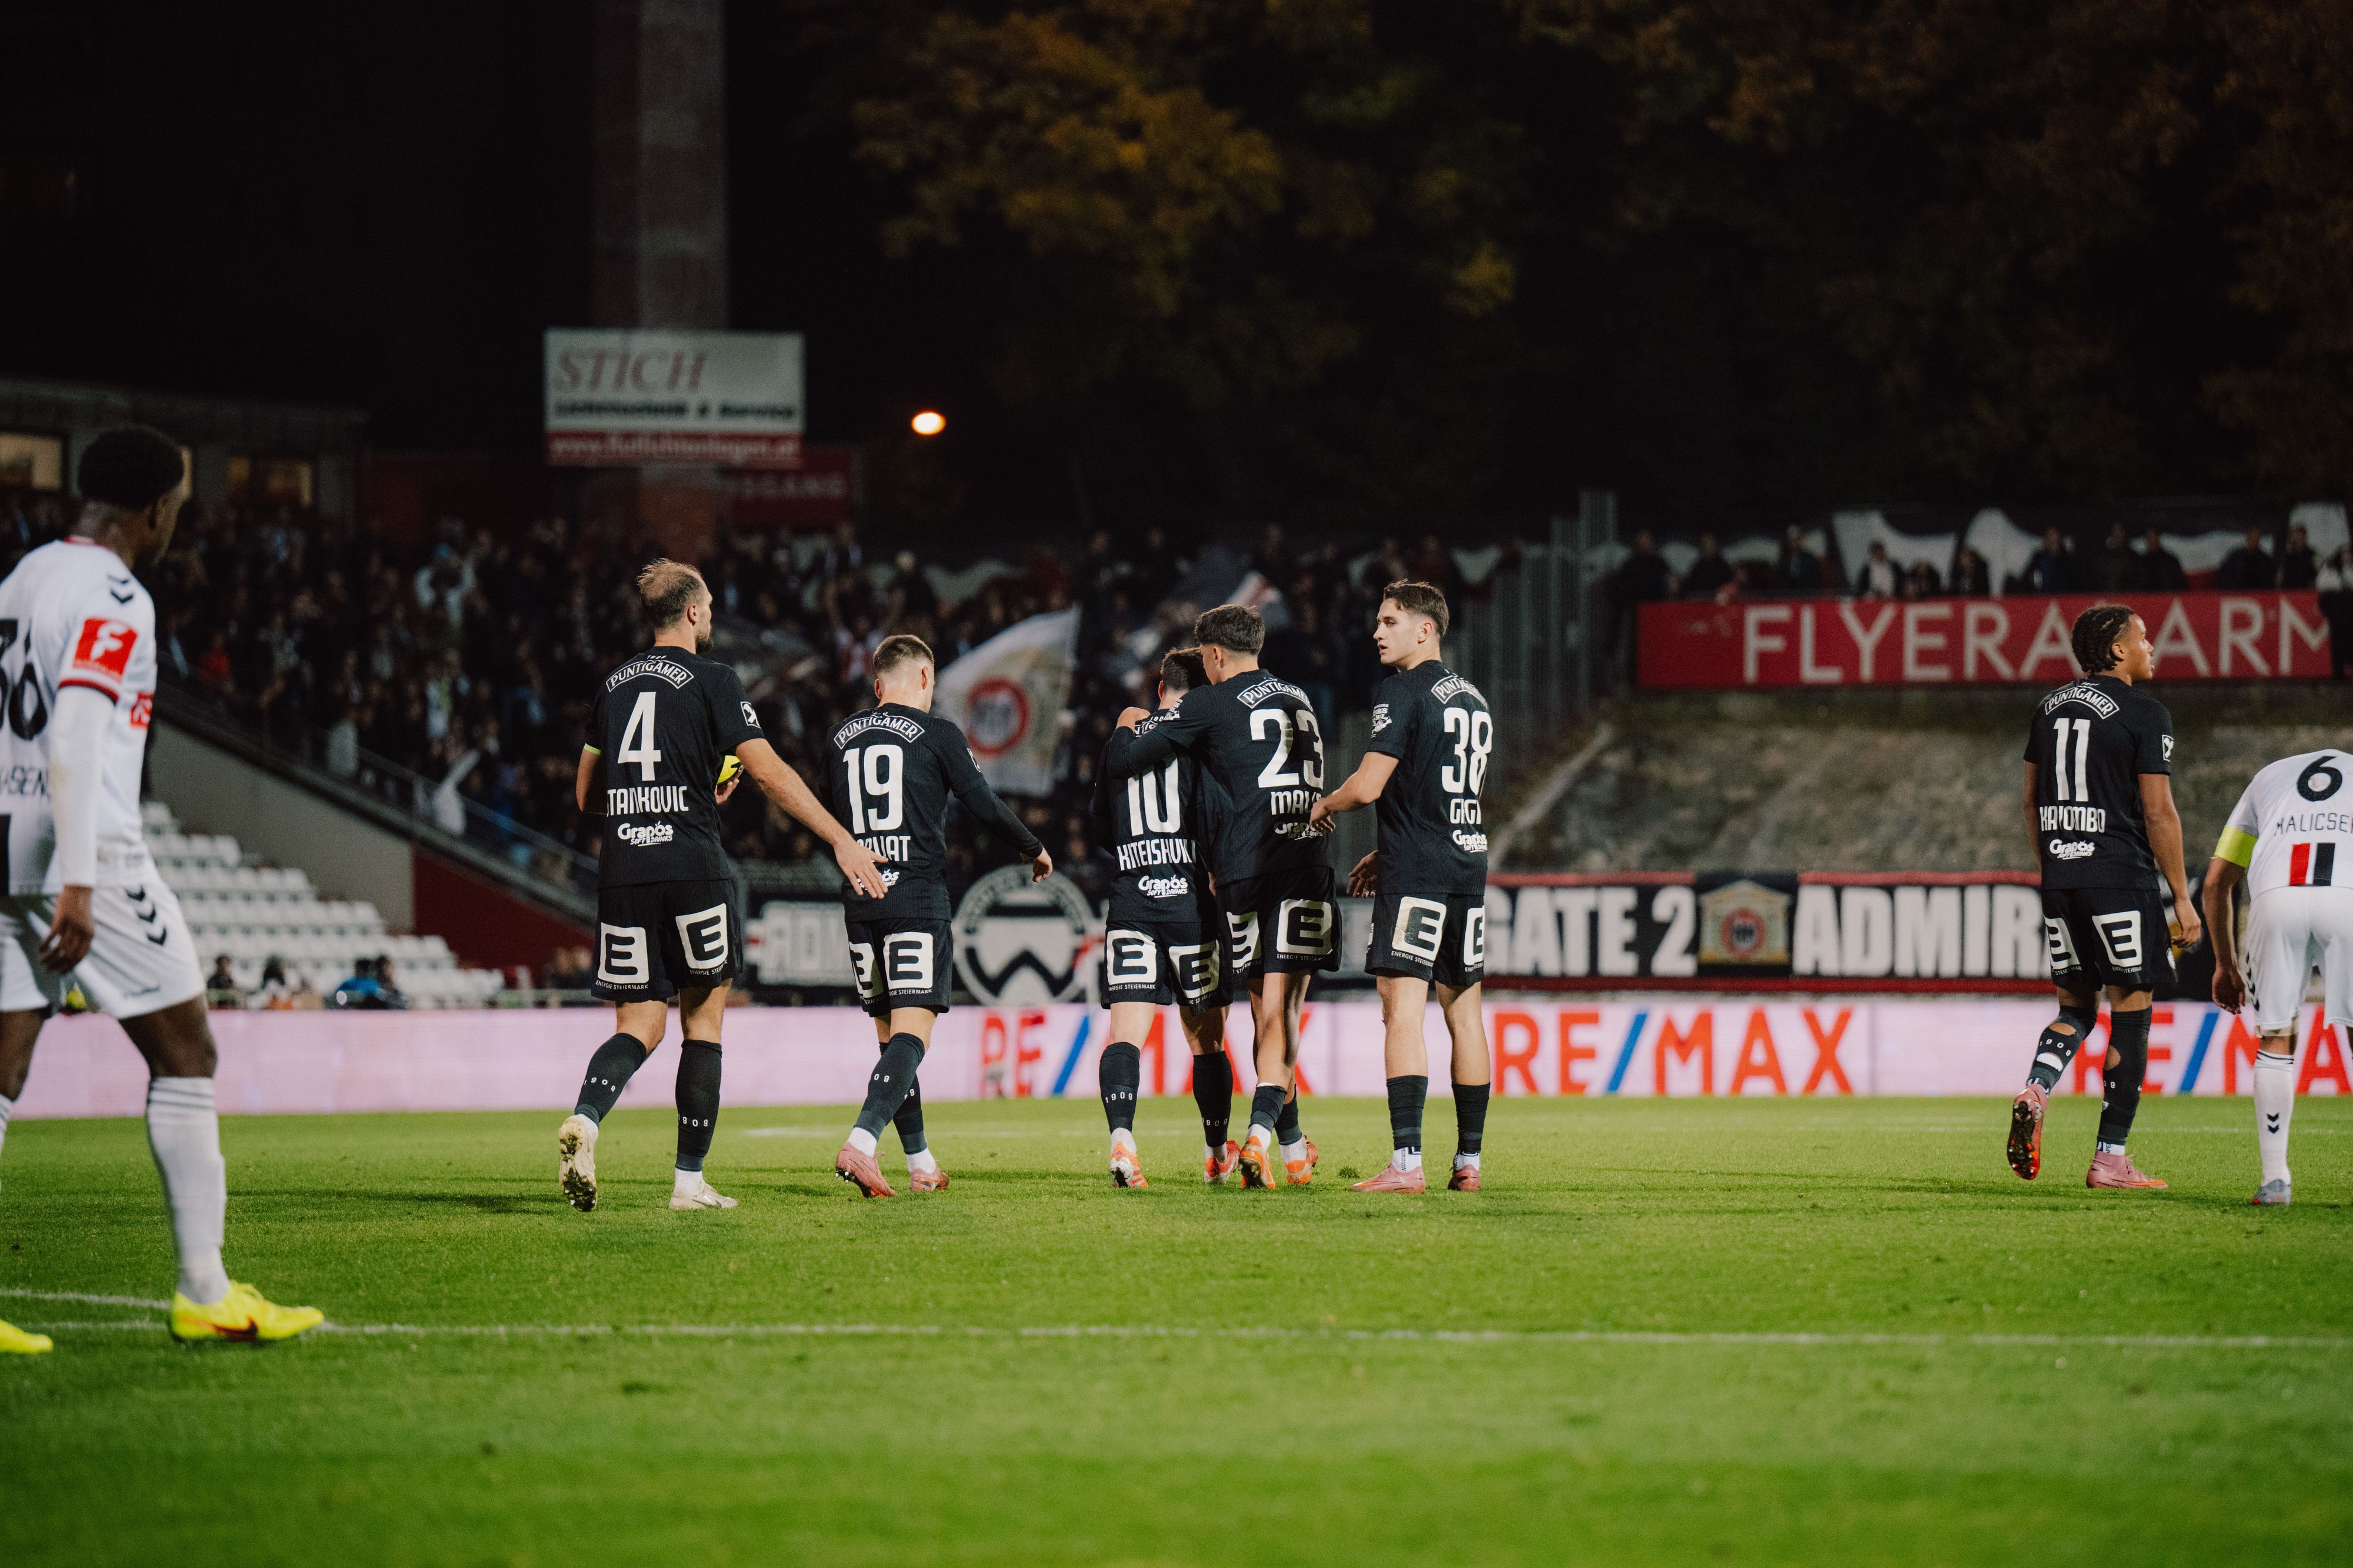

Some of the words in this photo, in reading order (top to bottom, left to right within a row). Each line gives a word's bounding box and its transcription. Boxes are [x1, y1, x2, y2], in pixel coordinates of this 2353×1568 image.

[555, 351, 706, 392] STICH
[610, 660, 688, 688] PUNTIGAMER
[1743, 596, 2331, 683] FLYERAARM
[618, 692, 661, 781] 4
[838, 715, 918, 743] PUNTIGAMER
[2048, 687, 2114, 716] PUNTIGAMER
[842, 744, 904, 835] 19
[1250, 708, 1324, 790] 23
[1442, 707, 1494, 795] 38
[2053, 718, 2091, 802] 11
[2296, 755, 2343, 802] 6
[606, 785, 689, 817] TANKOVIC
[1128, 755, 1181, 836] 10
[1391, 950, 1414, 960] ENERGIE
[1484, 885, 1638, 977] GATE
[1652, 885, 1696, 977] 2
[1793, 885, 2051, 979] ADMIR
[595, 979, 612, 989] ENERGIE
[1494, 1011, 1854, 1095] RE/MAX
[1104, 1092, 1134, 1104] 1909
